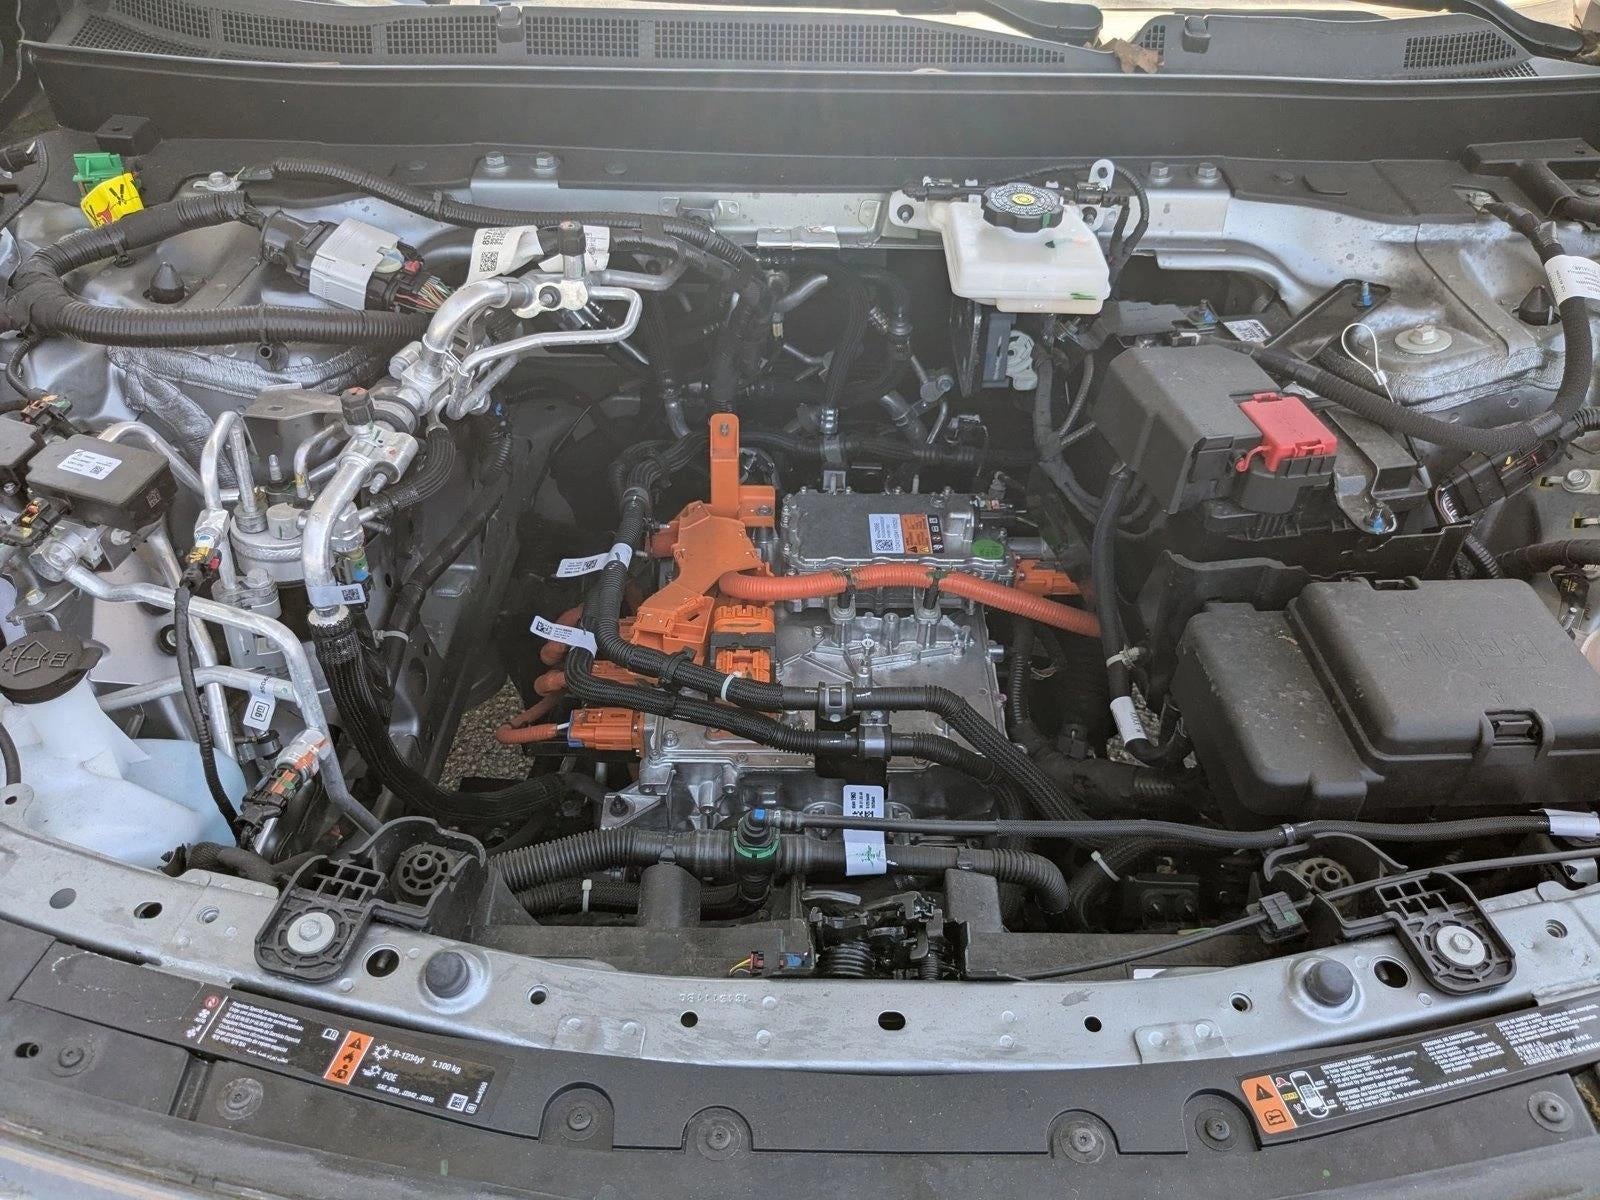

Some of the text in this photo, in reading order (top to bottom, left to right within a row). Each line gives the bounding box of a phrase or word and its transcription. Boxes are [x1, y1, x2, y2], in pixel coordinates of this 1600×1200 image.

[392, 1050, 461, 1074] R-1234yf 1.100 kg
[382, 1072, 398, 1082] POE
